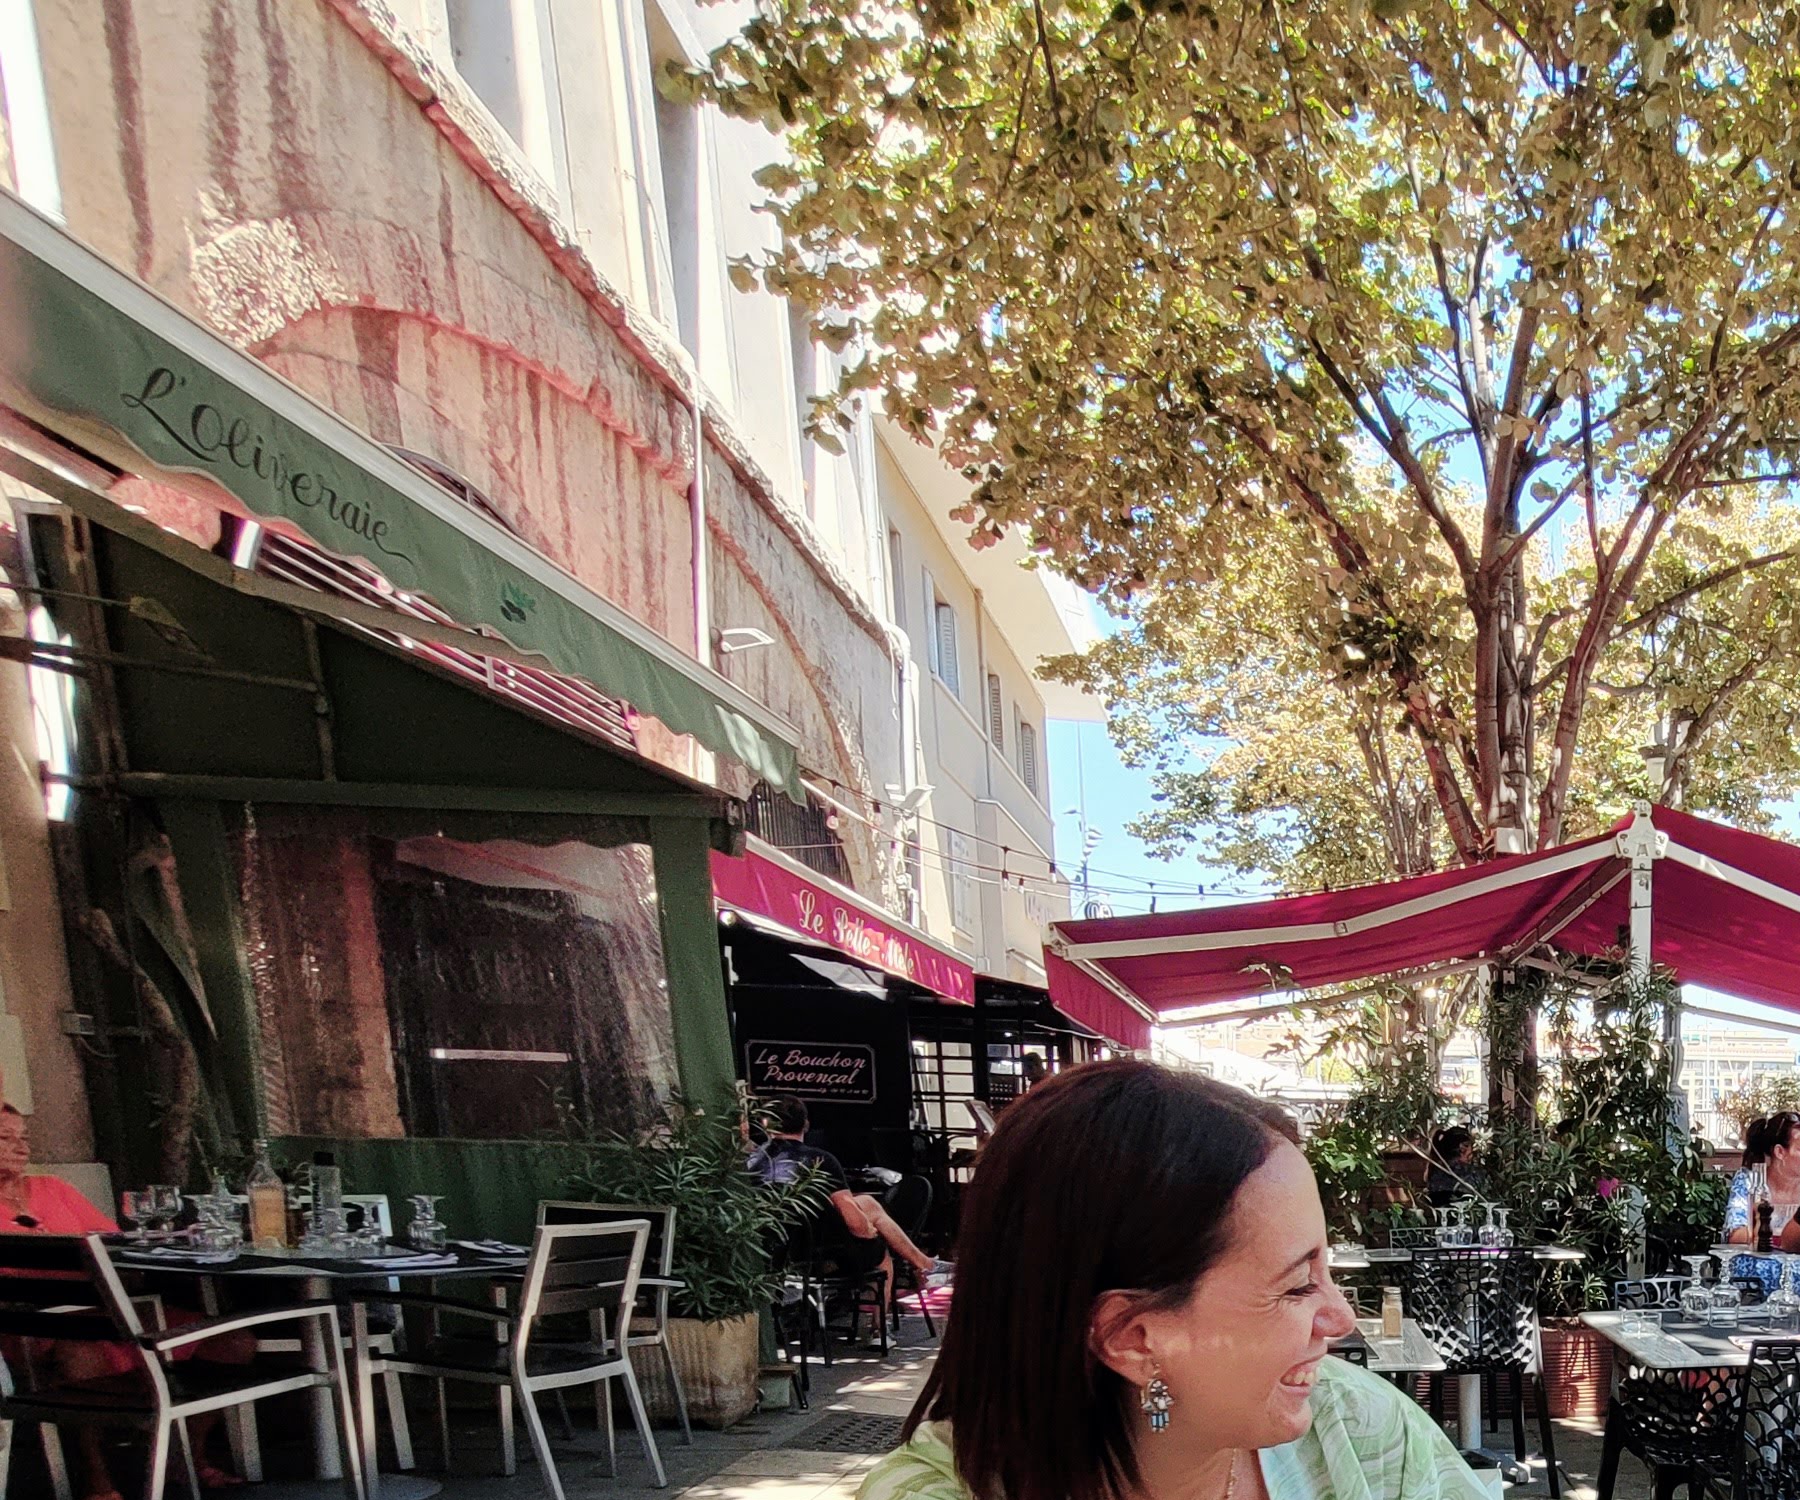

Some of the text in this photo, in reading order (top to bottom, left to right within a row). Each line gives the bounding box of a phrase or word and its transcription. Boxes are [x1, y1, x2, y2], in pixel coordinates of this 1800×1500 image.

[799, 889, 825, 935] Le
[754, 1048, 867, 1069] Le Bouchon
[763, 1065, 860, 1085] Provençal
